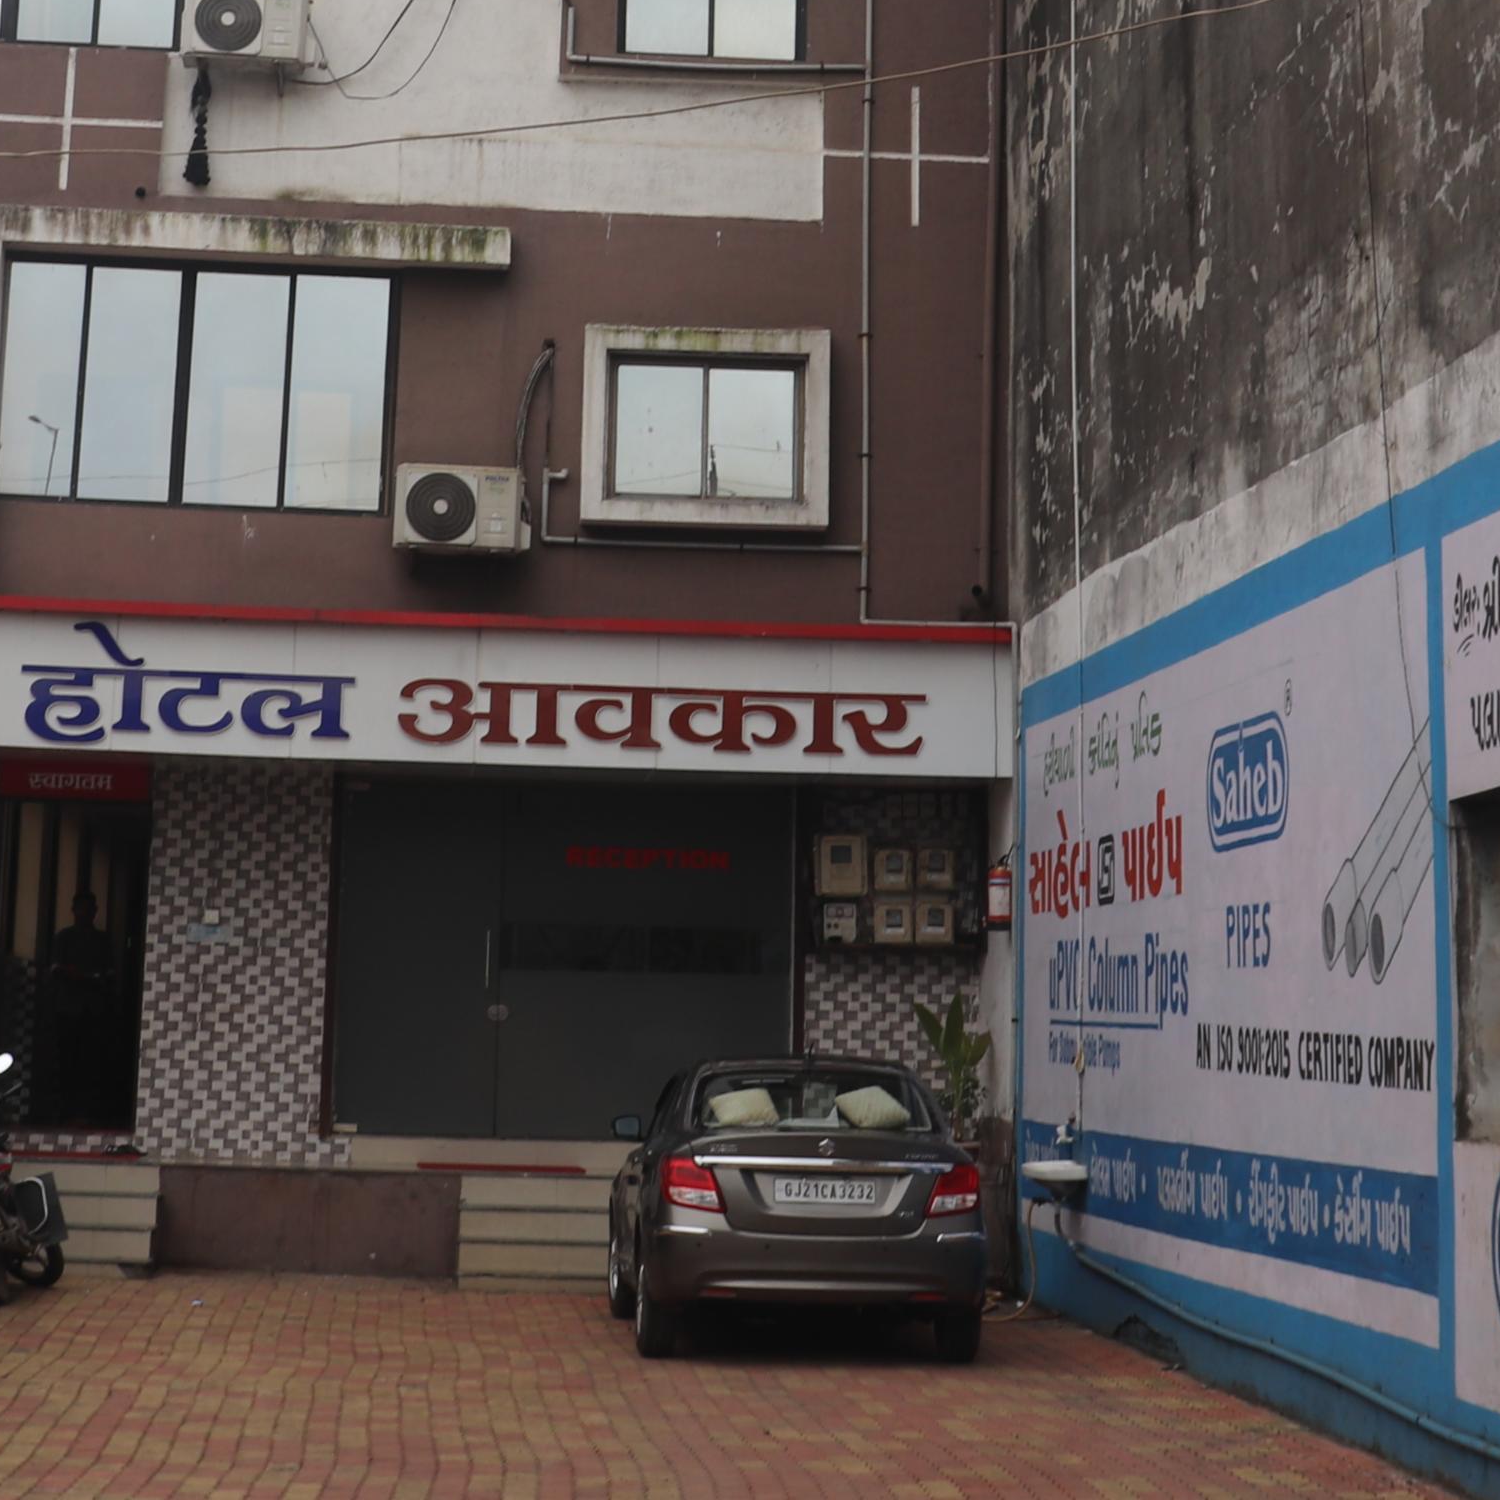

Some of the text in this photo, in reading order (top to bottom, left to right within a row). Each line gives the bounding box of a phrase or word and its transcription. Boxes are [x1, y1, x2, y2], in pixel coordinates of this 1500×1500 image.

[21, 620, 928, 756] होटल आवकार
[1211, 739, 1283, 828] Saheb
[565, 845, 731, 871] RECEPTION
[1226, 902, 1271, 968] PIPES
[1087, 935, 1139, 1014] Column
[1144, 932, 1189, 1031] Pipes
[1196, 1022, 1435, 1092] AN ISO 9001:2015 CERTIFIED COMPANY
[784, 1180, 873, 1200] GJ21CA3232
